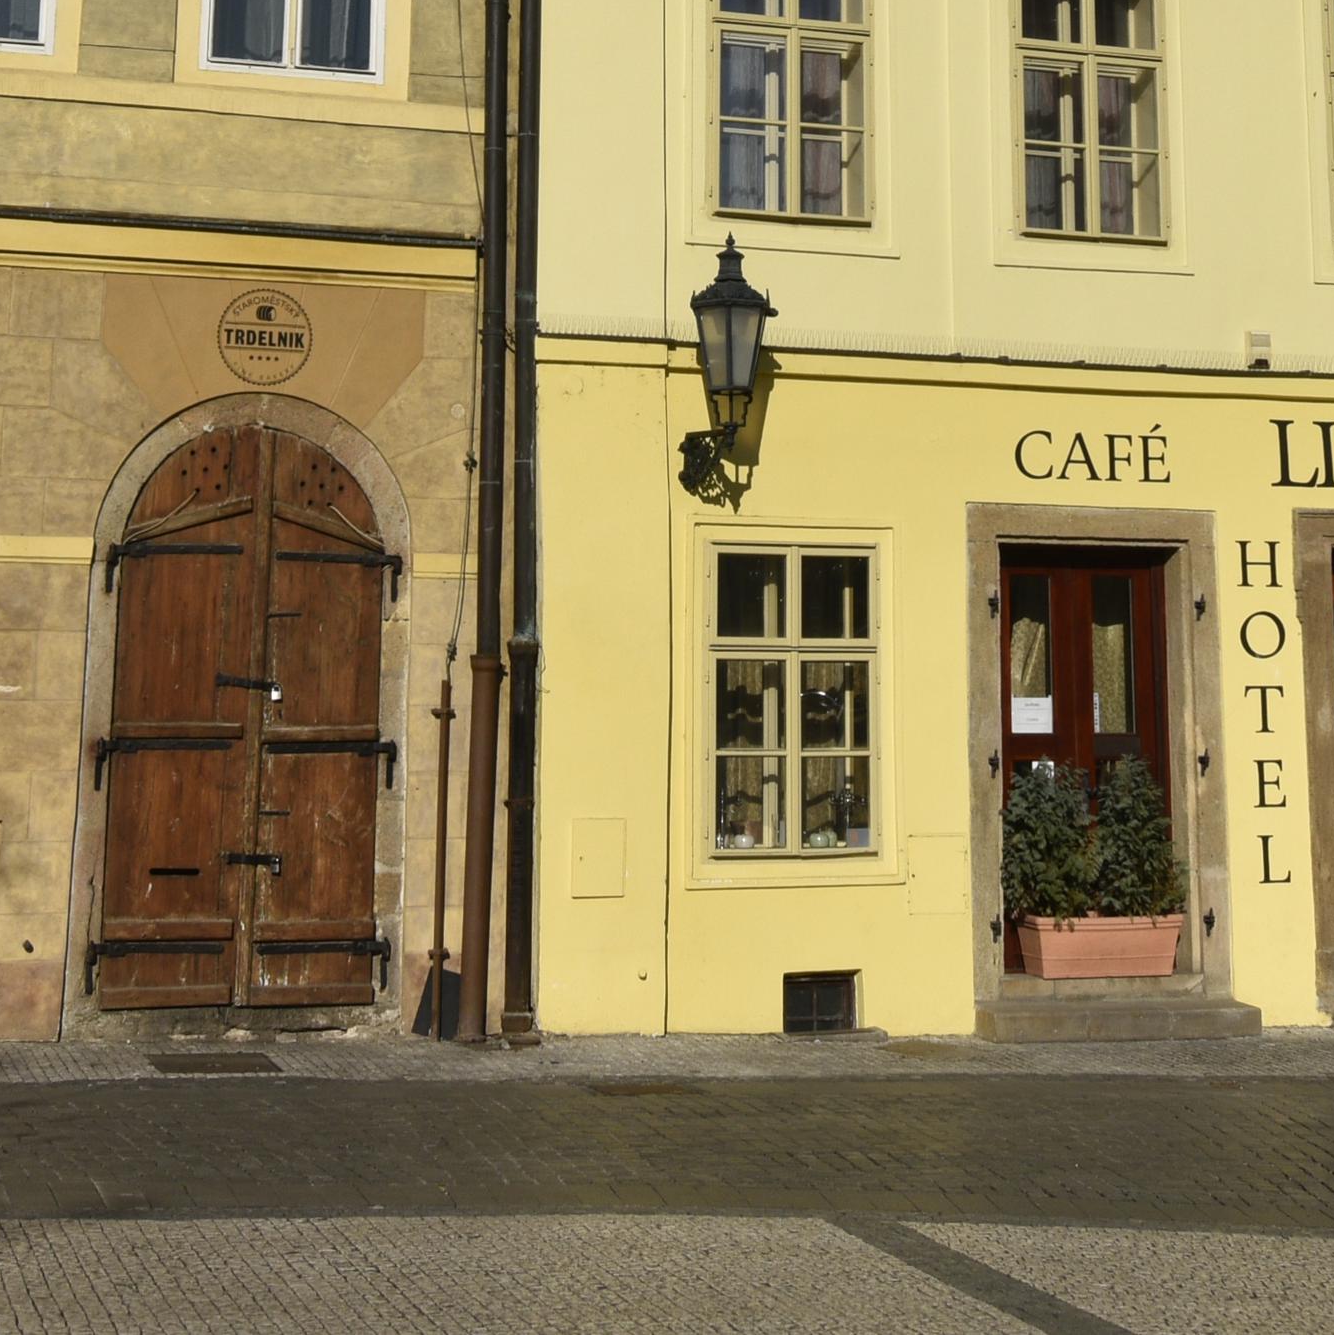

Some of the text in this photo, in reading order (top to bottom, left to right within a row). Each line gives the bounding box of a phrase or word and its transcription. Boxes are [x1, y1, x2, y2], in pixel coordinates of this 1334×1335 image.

[224, 328, 305, 349] TRDELNIK
[1014, 423, 1171, 484] CAFÉ
[1235, 540, 1292, 885] HOTEL
